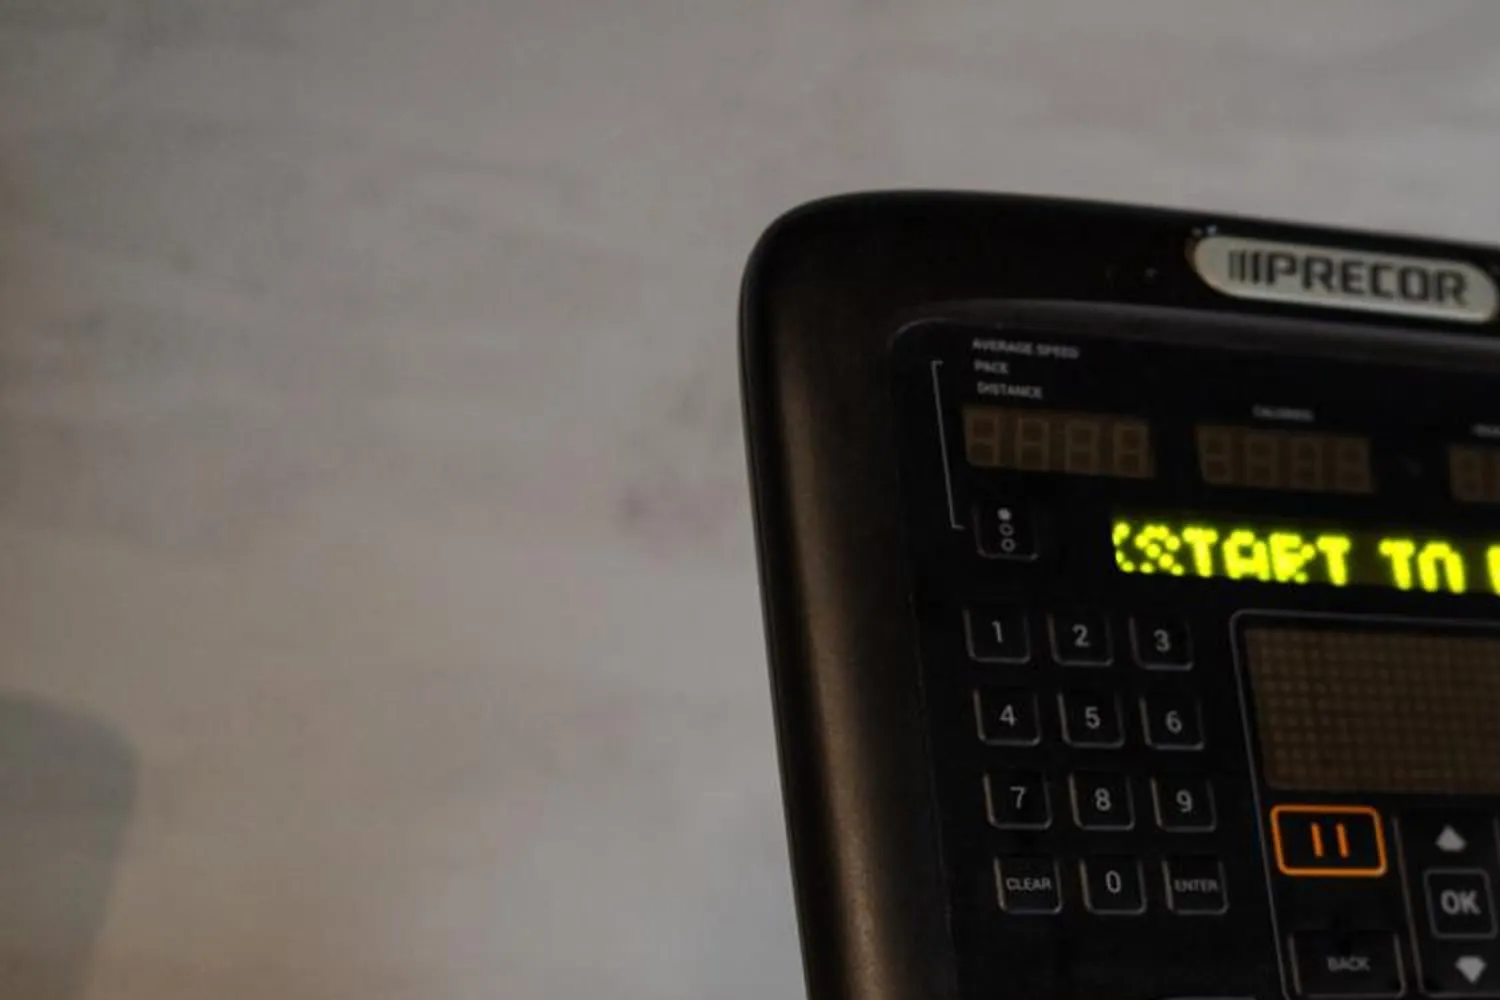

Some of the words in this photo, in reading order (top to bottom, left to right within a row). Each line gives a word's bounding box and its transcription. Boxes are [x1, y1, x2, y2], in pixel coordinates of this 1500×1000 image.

[1264, 251, 1469, 307] PRECOR
[974, 359, 1009, 374] PACE
[977, 381, 1043, 399] DISTANCE
[991, 620, 1003, 643] 1
[1072, 624, 1091, 648] 2
[1153, 629, 1172, 652] 3
[999, 704, 1017, 726] 4
[1084, 706, 1101, 729] 5
[1165, 710, 1183, 734] 6
[1010, 786, 1027, 809] 7
[1094, 787, 1111, 811] 8
[1175, 789, 1193, 812] 9
[1006, 877, 1051, 891] CLEAR
[1105, 869, 1122, 893] 0
[1174, 879, 1219, 893] ENTER
[1440, 891, 1482, 916] OK
[1327, 956, 1371, 972] BACK
